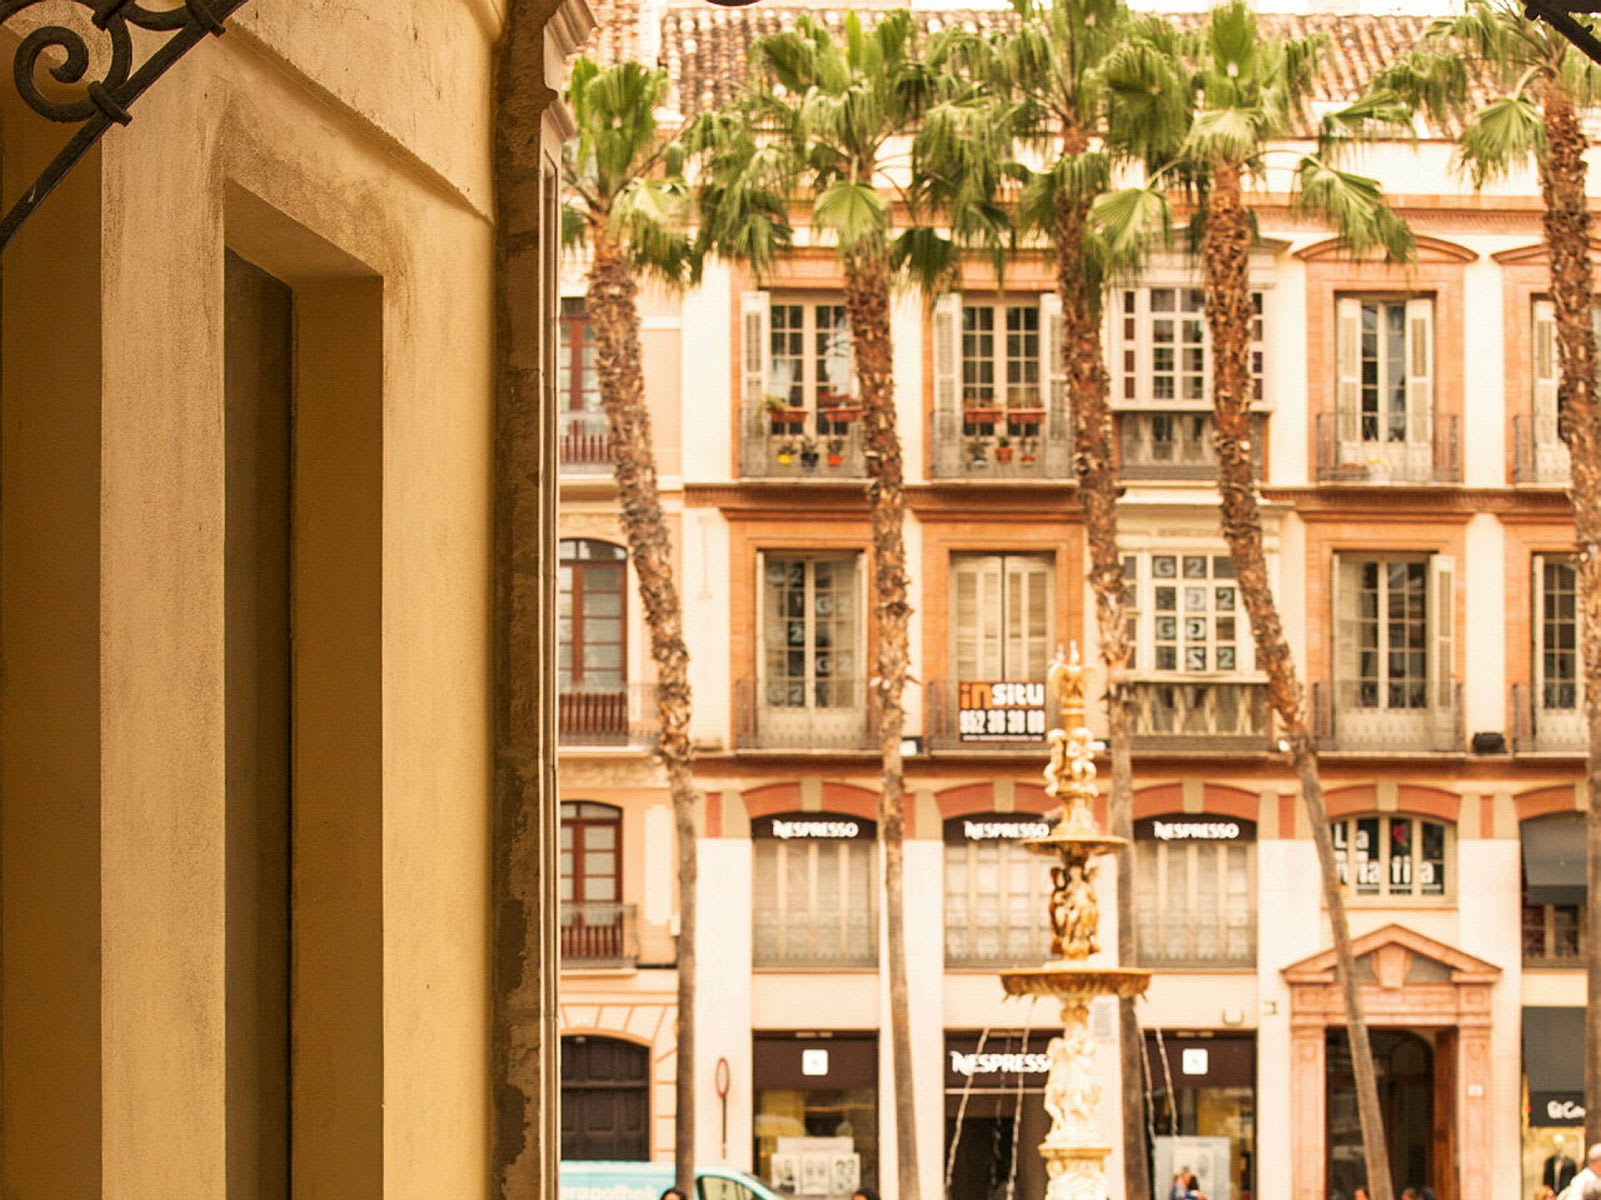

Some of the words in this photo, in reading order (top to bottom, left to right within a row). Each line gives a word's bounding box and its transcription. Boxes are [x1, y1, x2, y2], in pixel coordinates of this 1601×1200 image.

[772, 820, 859, 839] NESPRESSO
[963, 821, 1050, 840] NESPRESSO
[1153, 821, 1240, 840] NESPRESSO
[1334, 822, 1369, 849] La
[949, 1050, 1051, 1076] NESPRESS
